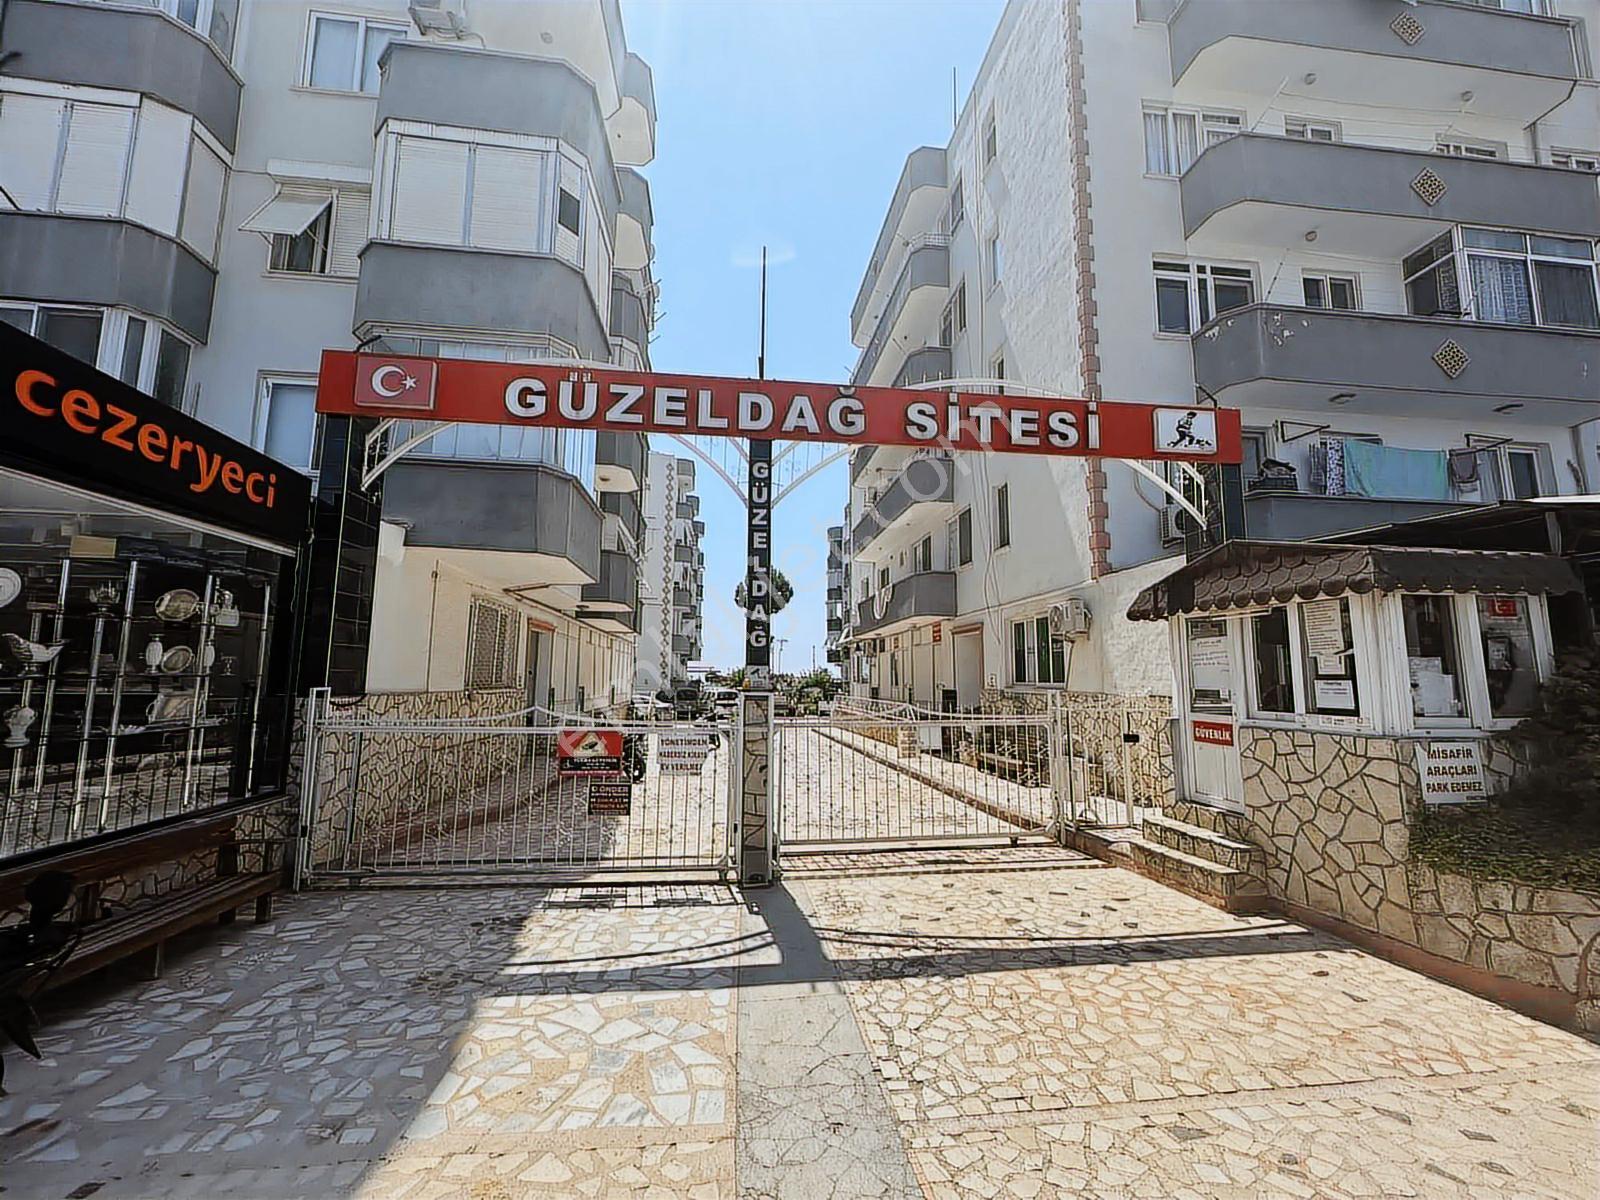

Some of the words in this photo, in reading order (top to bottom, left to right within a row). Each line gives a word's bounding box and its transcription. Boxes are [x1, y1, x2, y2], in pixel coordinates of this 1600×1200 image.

[504, 371, 866, 436] GÜZELDAĞ
[905, 392, 1101, 449] SİTESİ
[15, 368, 277, 508] cezeryeci
[750, 462, 770, 647] GÜZELDAĞ
[1195, 725, 1231, 741] GÜVENLİK
[1427, 746, 1474, 759] MİSAFİR
[1427, 765, 1477, 778] ARAÇLARI
[1426, 782, 1450, 793] PARK
[1450, 781, 1483, 792] EDEMEZ
